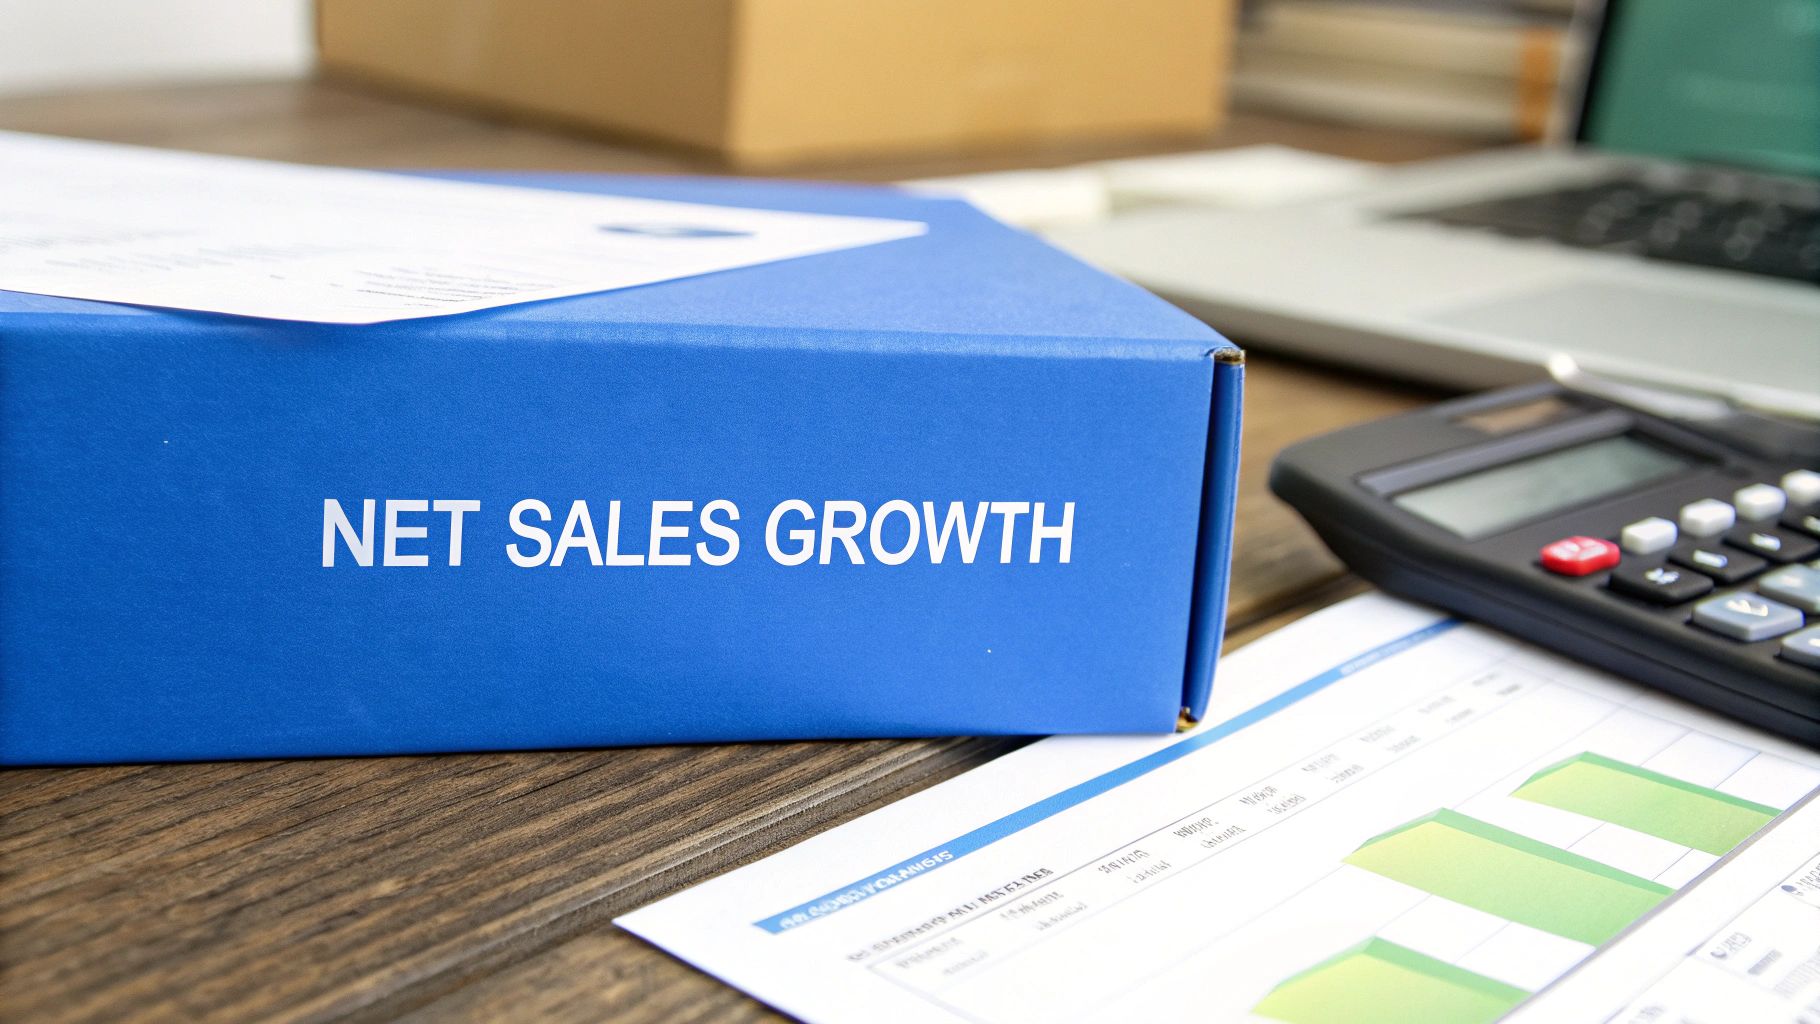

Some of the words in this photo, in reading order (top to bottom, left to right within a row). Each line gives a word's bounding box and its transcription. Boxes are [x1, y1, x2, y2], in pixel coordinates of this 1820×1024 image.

[321, 498, 481, 567] NET
[505, 498, 741, 567] SALES
[764, 498, 1076, 566] GROWTH
